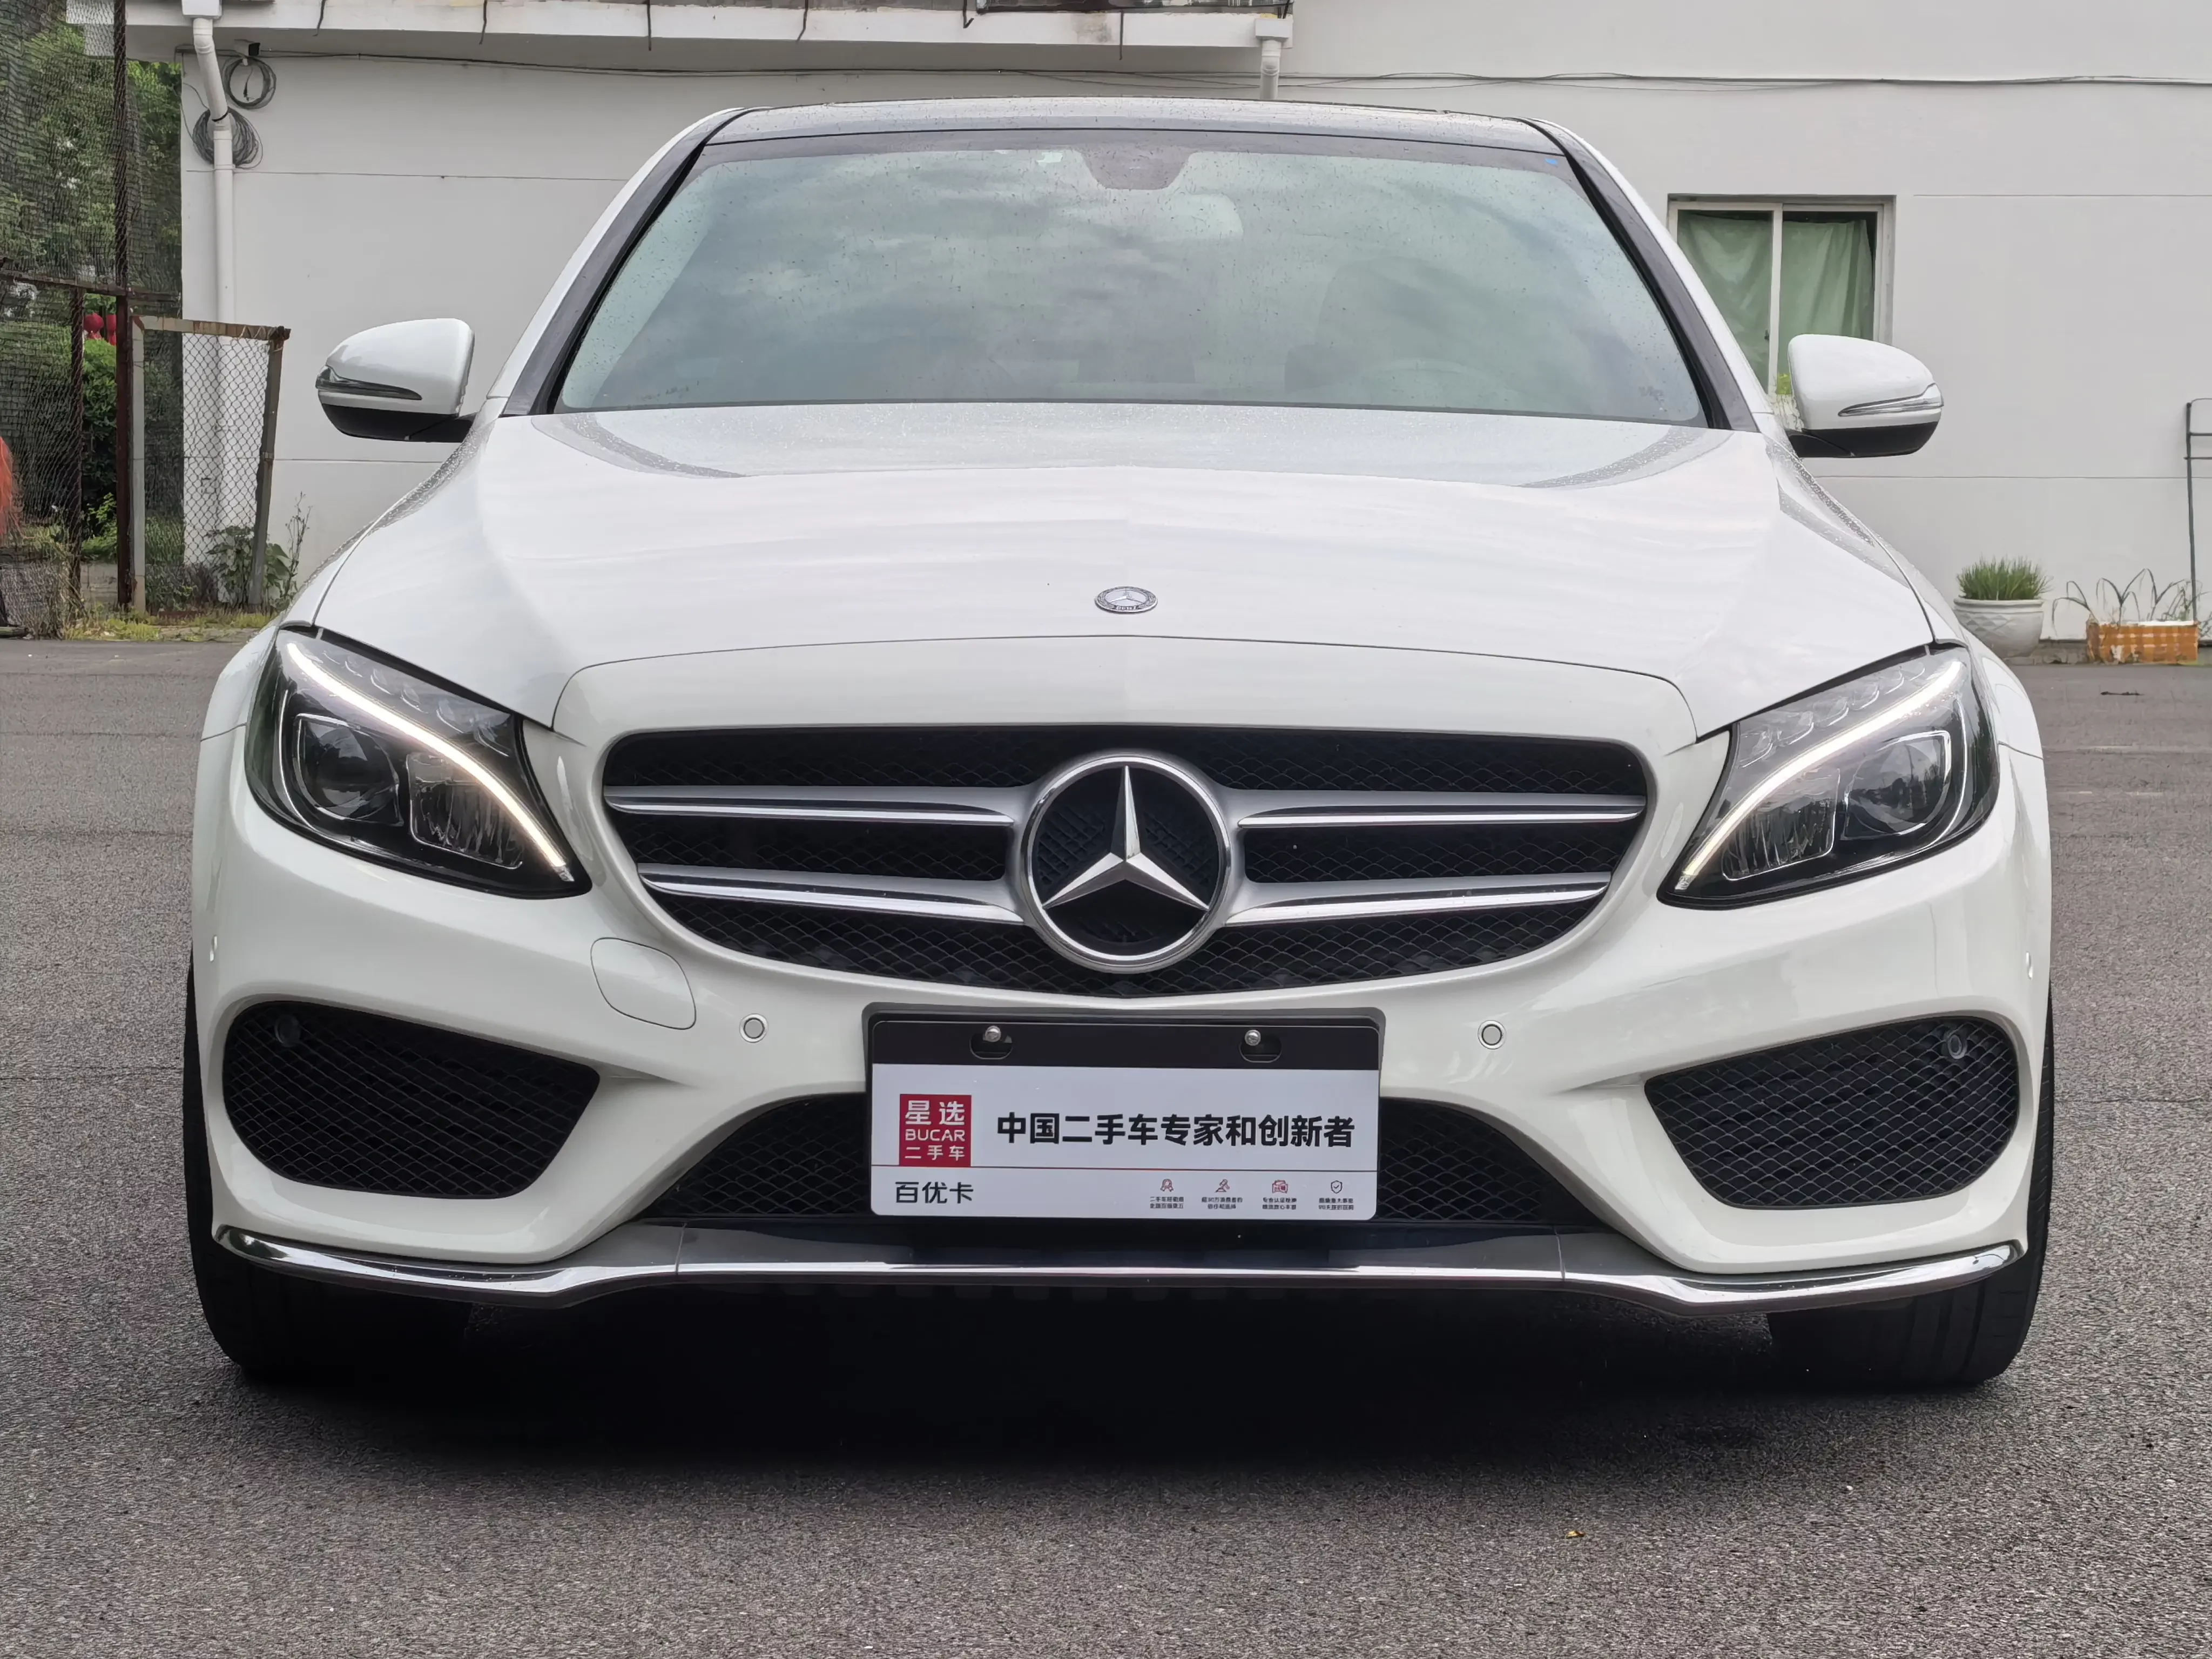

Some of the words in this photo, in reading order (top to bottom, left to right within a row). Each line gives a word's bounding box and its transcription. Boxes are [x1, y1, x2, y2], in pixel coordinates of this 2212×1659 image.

[905, 1100, 965, 1125] 星选
[905, 1129, 965, 1142] BUCAR
[997, 1111, 1355, 1148] 中国二手车专家和创新者
[905, 1145, 965, 1161] 二手车
[895, 1181, 974, 1204] 百优卡
